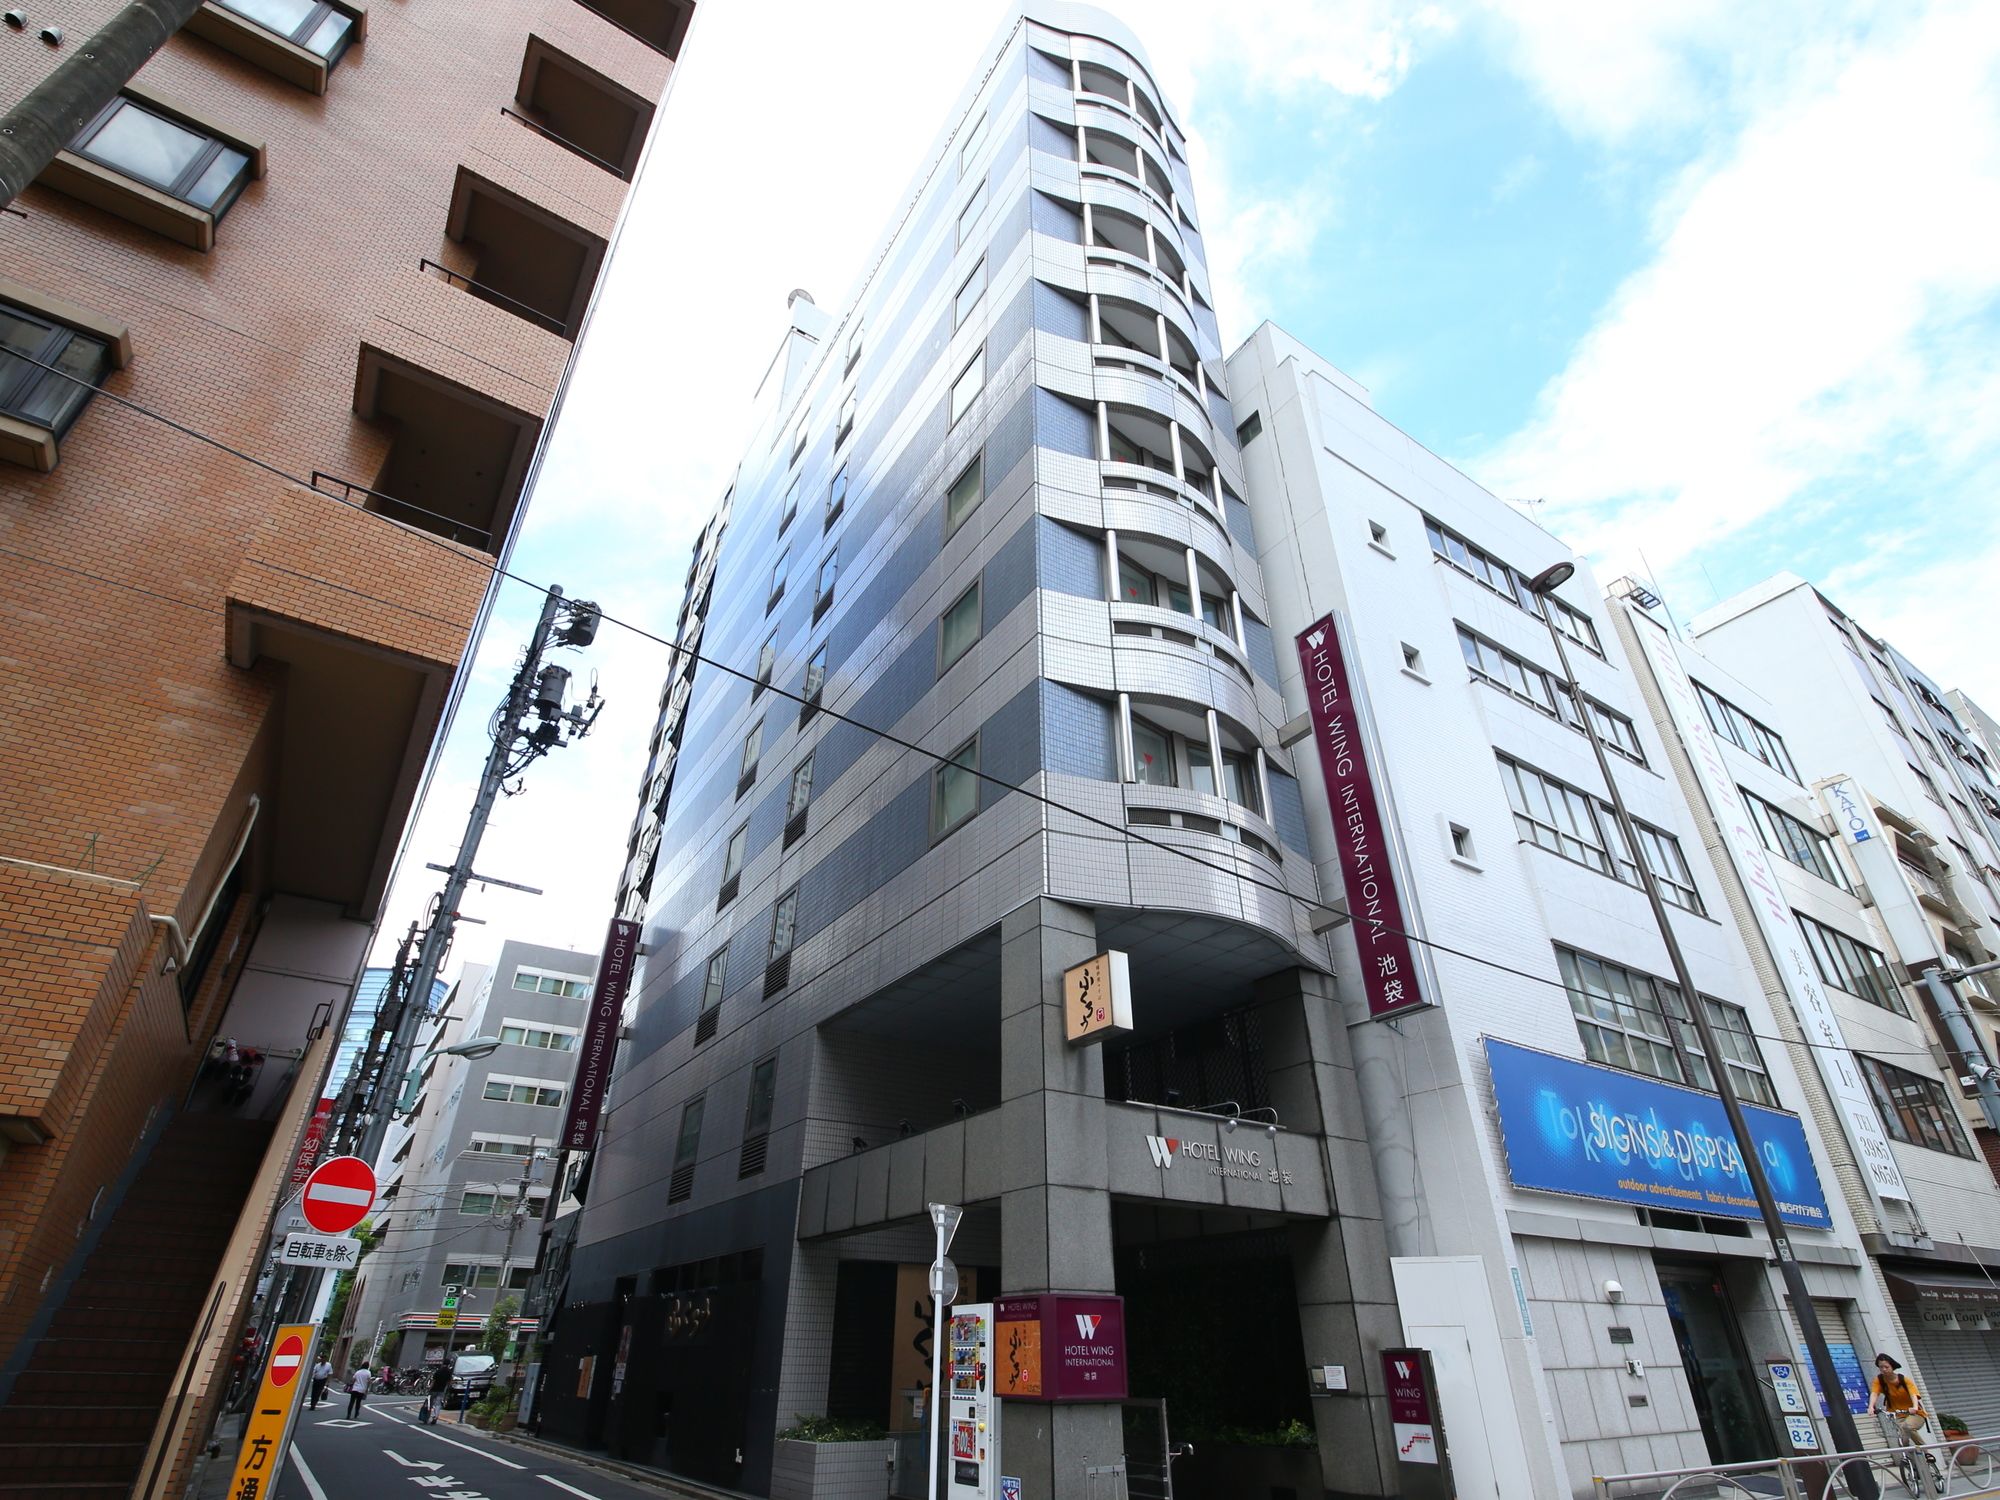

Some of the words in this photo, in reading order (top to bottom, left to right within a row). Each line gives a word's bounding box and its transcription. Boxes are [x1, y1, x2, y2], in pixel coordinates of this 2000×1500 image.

[1314, 649, 1338, 714] HOTEL
[1328, 714, 1353, 777] WING
[1341, 783, 1387, 945] INTERNATIONAL
[1830, 783, 1865, 831] KATO
[609, 938, 628, 976] HOTEL
[1377, 953, 1405, 1004] 池袋
[600, 981, 618, 1017] WING
[1079, 968, 1095, 1033] ふくろう
[1789, 947, 1840, 1051] 美容室
[578, 1021, 608, 1112] INTERNATIONAL
[572, 1118, 588, 1146] 池袋
[1853, 1112, 1876, 1133] TEL
[1181, 1140, 1221, 1161] HOTEL
[1224, 1146, 1261, 1167] WING
[1860, 1136, 1890, 1161] 3985
[1208, 1167, 1263, 1182] INTERNATIONAL
[1268, 1168, 1294, 1185] 池袋
[1870, 1163, 1900, 1187] 8659
[1618, 1178, 1648, 1193] outdoor
[1649, 1181, 1702, 1201] advertisements
[1706, 1190, 1726, 1204] fabric
[287, 1241, 355, 1263] 自転車を除く
[446, 1286, 457, 1297] P
[1065, 1346, 1089, 1356] HOTEL
[1091, 1346, 1115, 1356] WING
[1065, 1359, 1115, 1367] INTERNATIONAL
[1775, 1366, 1788, 1377] 254
[1395, 1388, 1421, 1398] WING
[1786, 1394, 1796, 1406] 5
[1792, 1430, 1815, 1443] 8.2
[236, 1409, 281, 1500] 一方通
